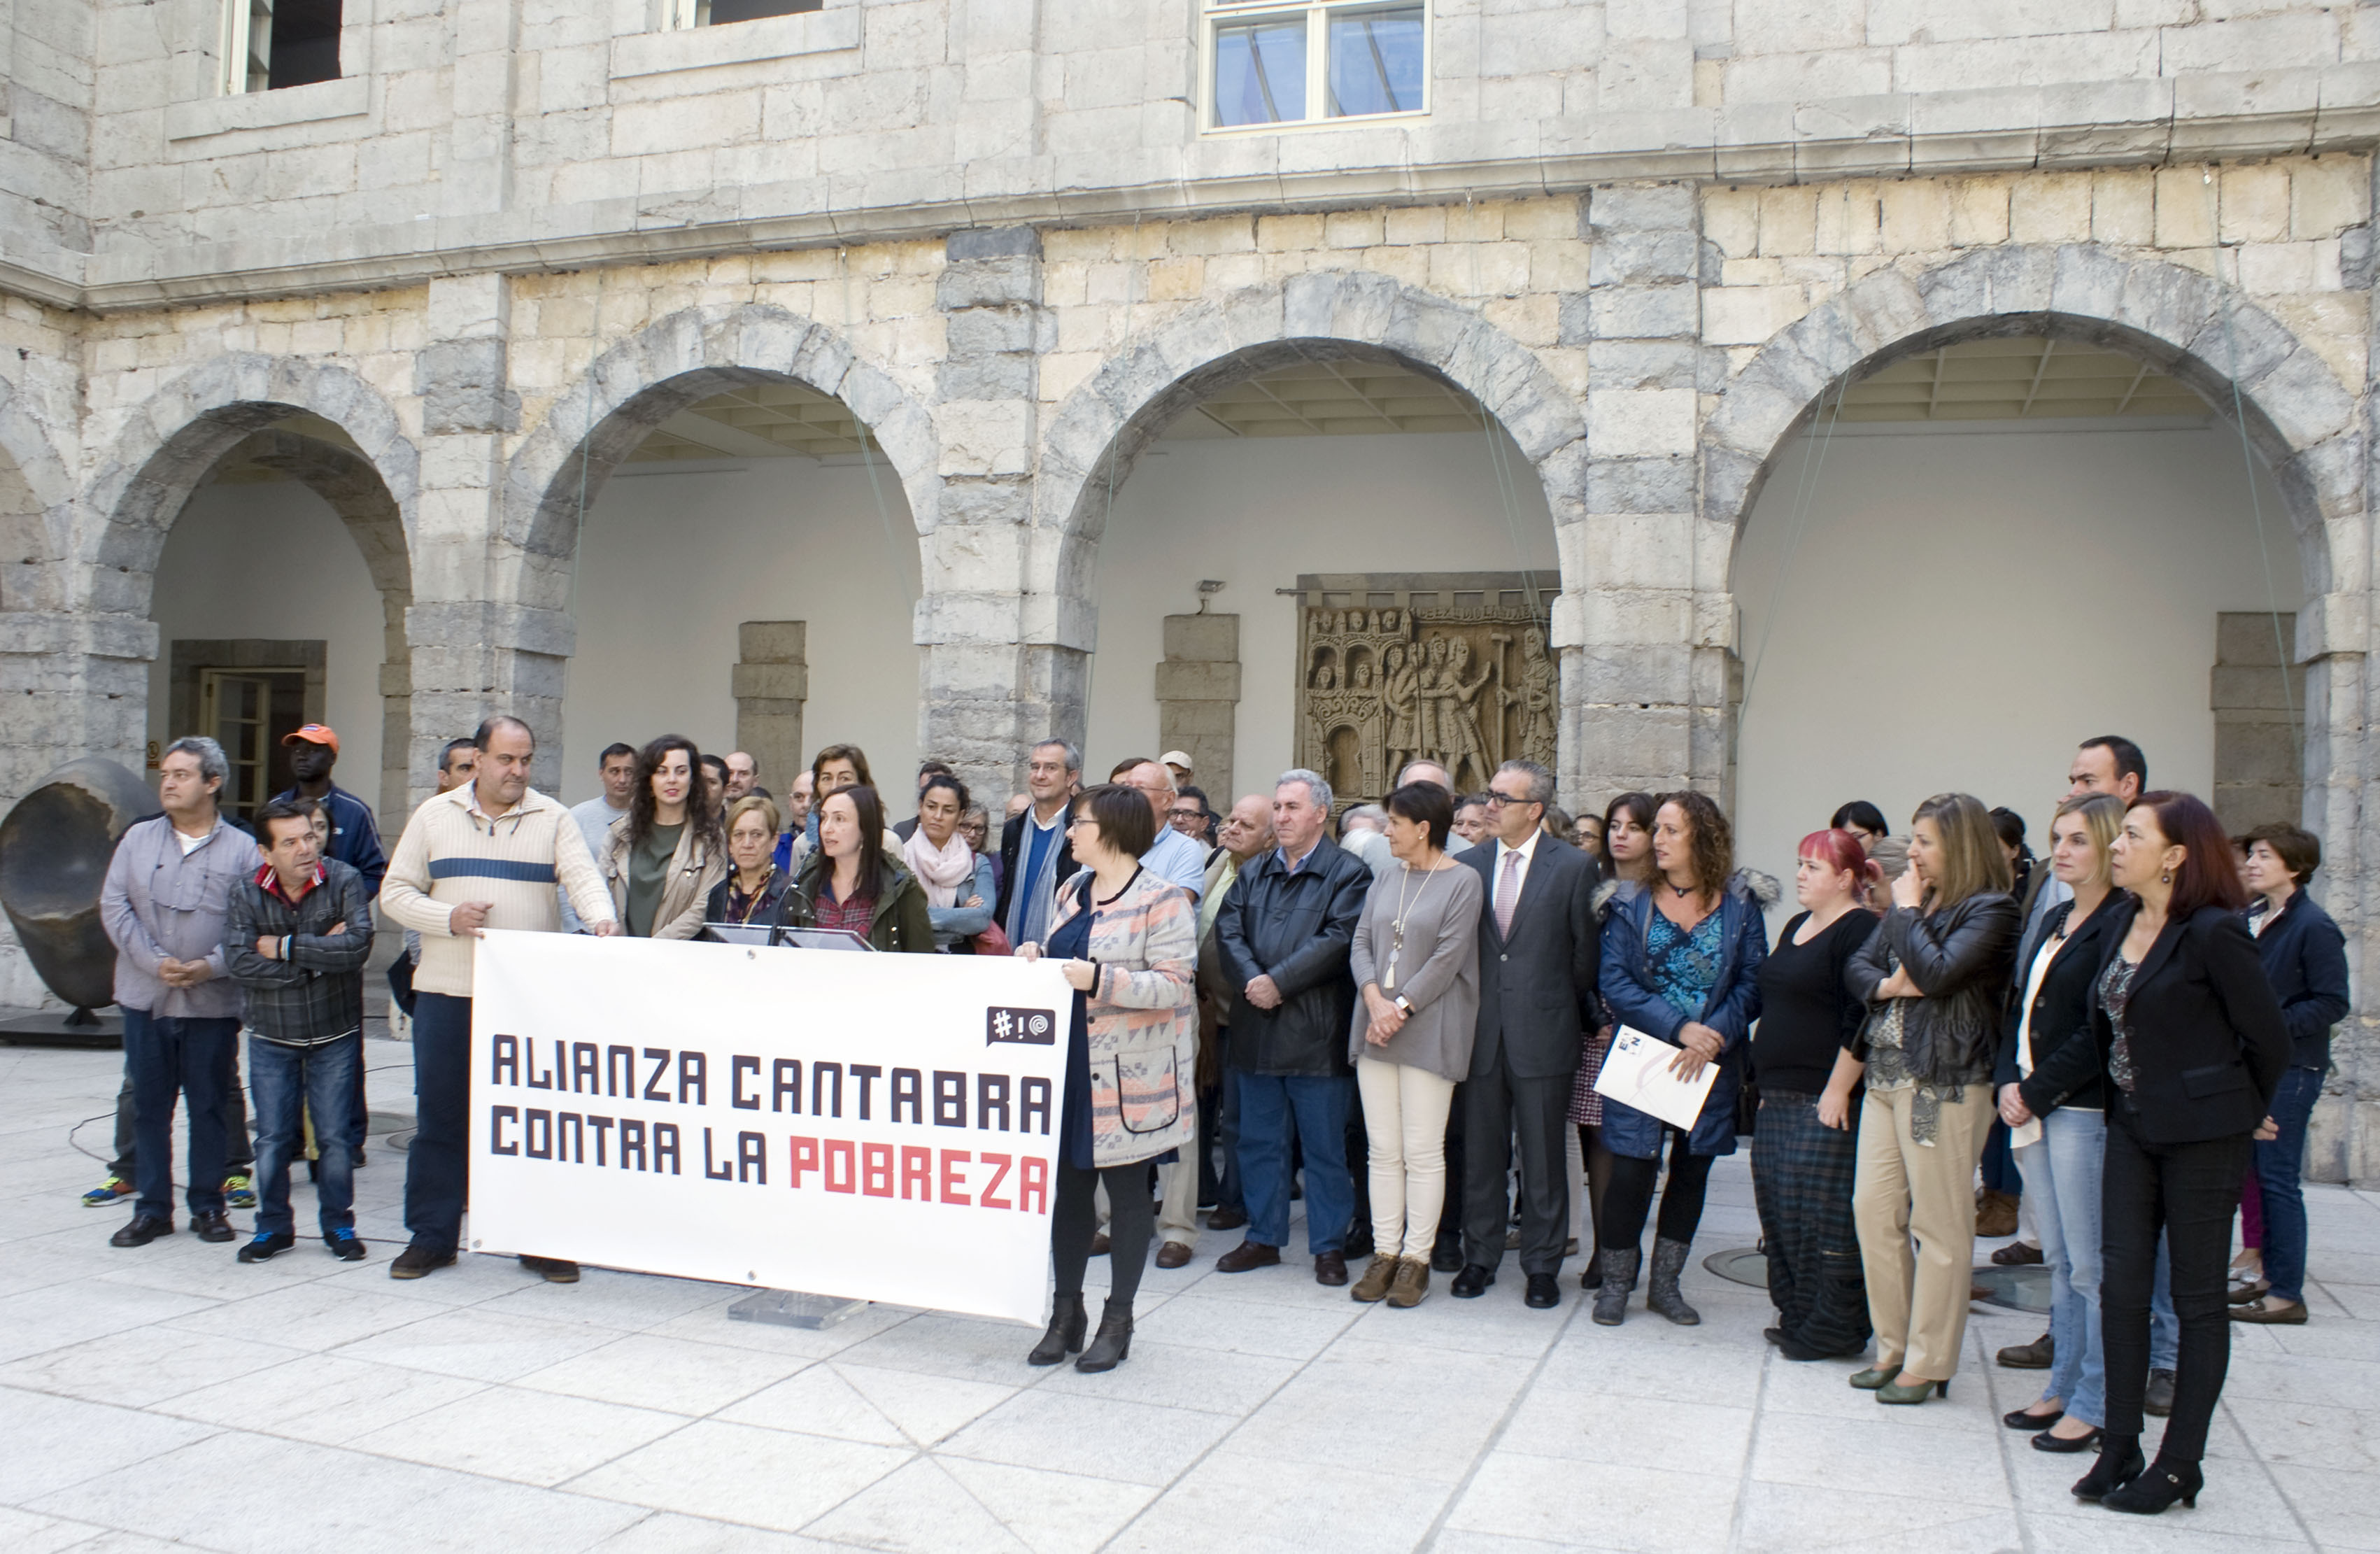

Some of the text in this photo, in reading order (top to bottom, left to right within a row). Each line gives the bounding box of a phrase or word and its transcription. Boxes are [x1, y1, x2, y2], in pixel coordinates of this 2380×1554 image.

[491, 1033, 1053, 1136] ALIANZA CANTABRA
[490, 1105, 1049, 1215] CONTRA LA POBREZA
